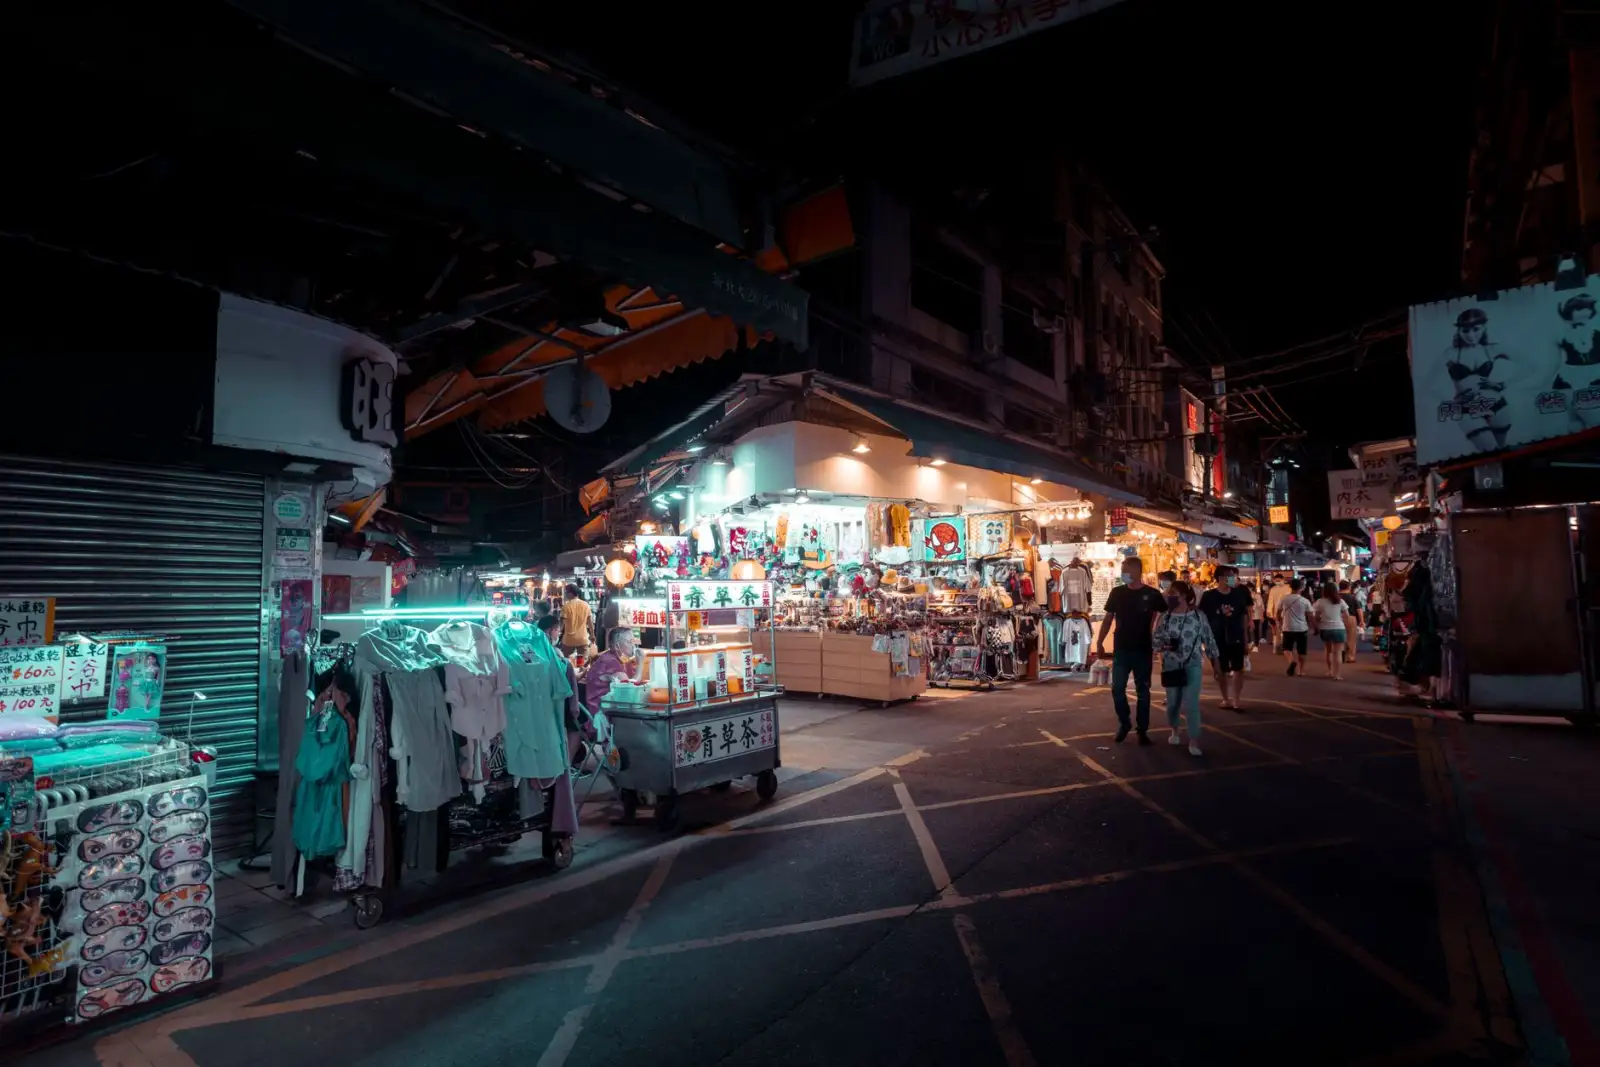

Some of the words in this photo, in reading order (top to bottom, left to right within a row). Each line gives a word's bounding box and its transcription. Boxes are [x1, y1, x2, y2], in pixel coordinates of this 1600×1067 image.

[684, 584, 760, 608] 青草茶
[677, 662, 689, 701] 酸梅湯
[700, 716, 759, 759] 青草茶
